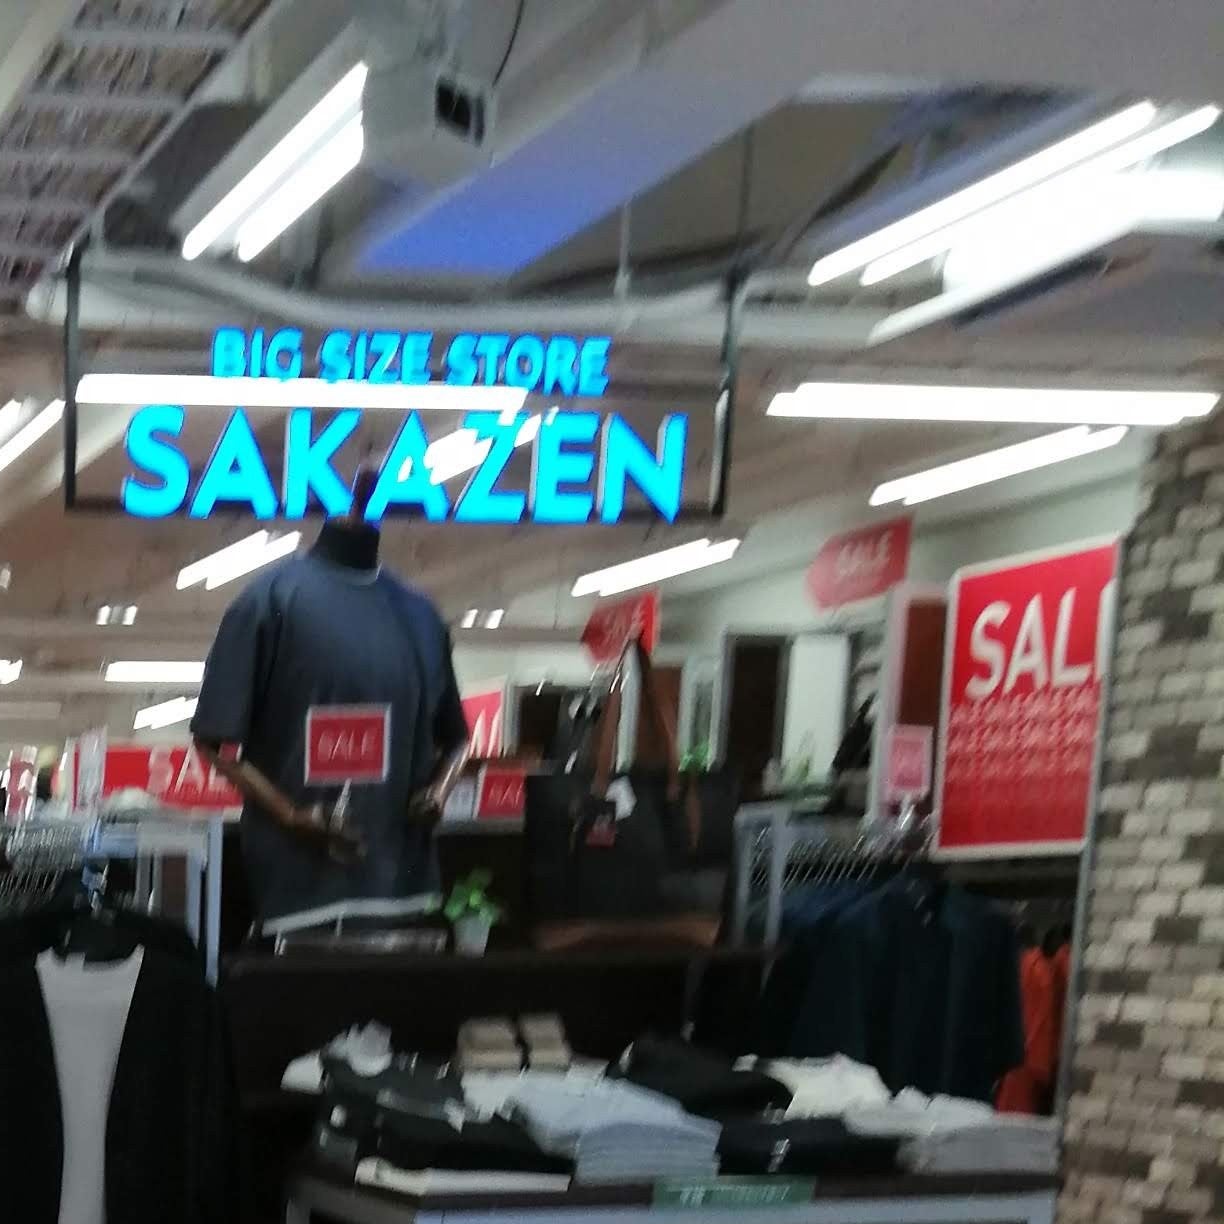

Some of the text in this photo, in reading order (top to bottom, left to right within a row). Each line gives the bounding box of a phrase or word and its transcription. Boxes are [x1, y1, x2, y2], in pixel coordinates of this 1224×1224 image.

[212, 326, 613, 396] BIG SIZE STORE
[122, 404, 689, 525] SAKAZEN
